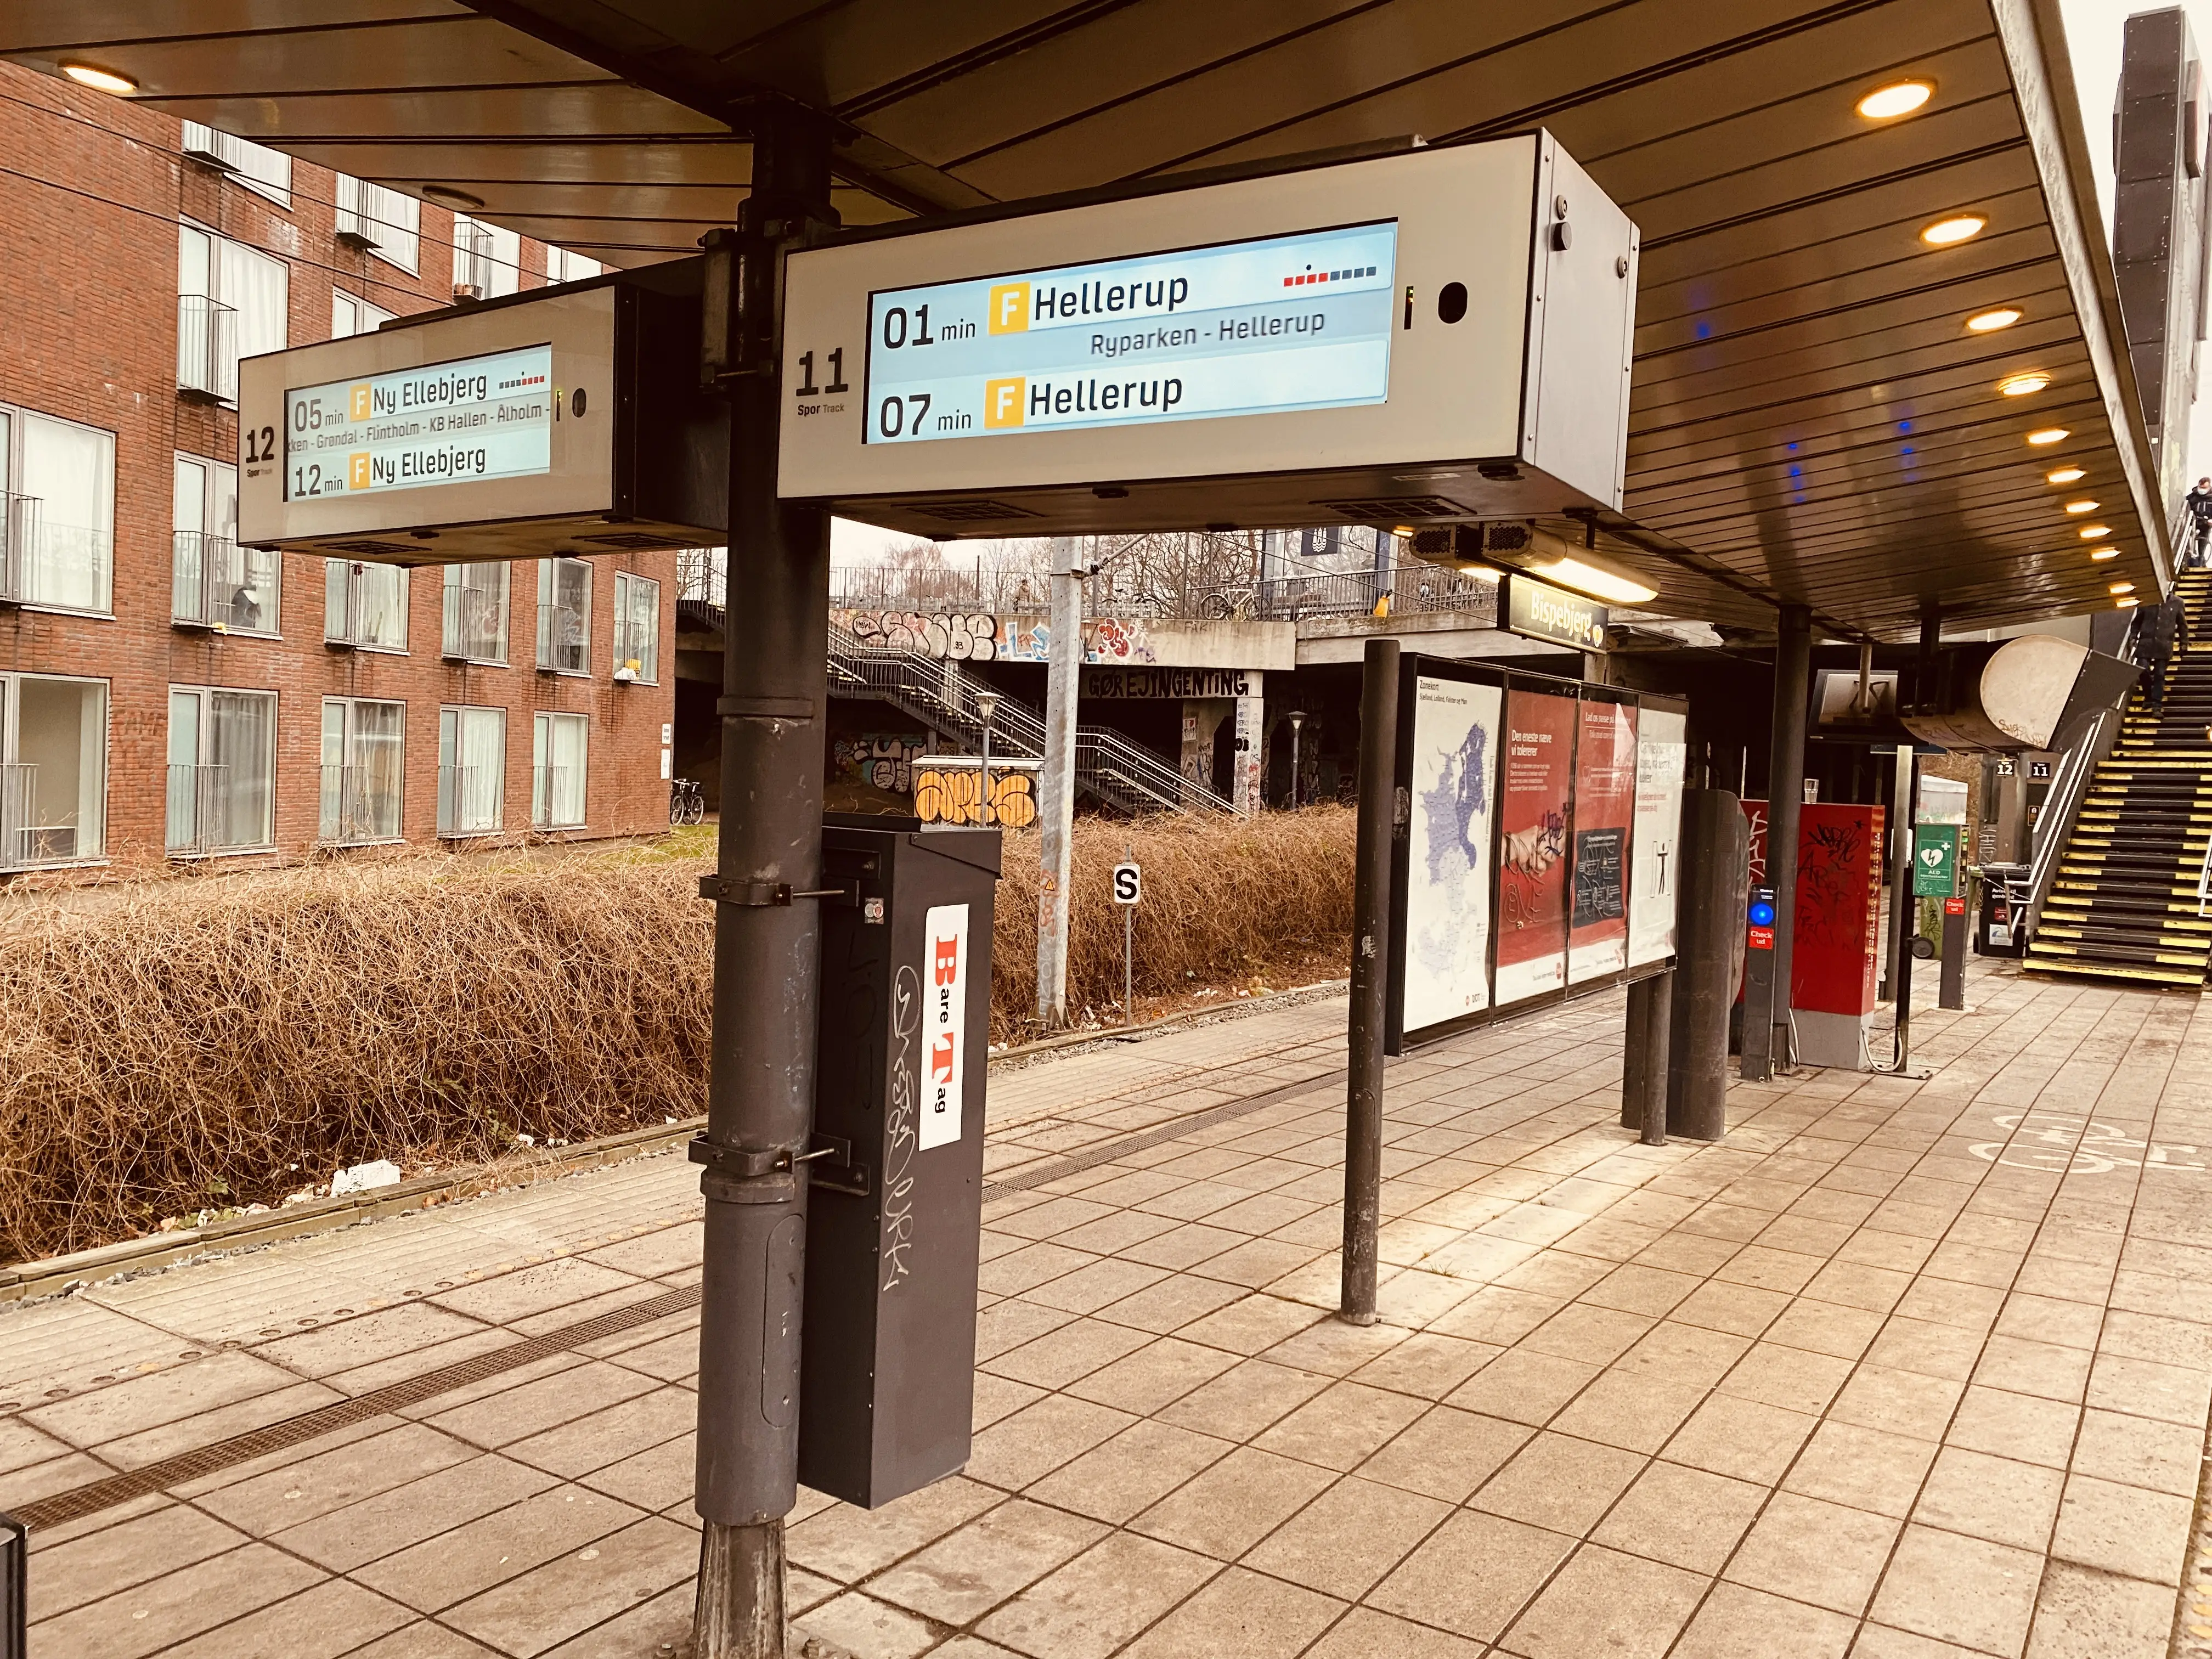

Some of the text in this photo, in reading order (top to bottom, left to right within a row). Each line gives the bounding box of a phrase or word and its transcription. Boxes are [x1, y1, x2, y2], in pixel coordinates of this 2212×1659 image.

[884, 277, 1188, 349] 01 min F Hellerup
[1091, 327, 1197, 358] Ryparken
[1219, 313, 1325, 341] Hellerup
[796, 347, 848, 397] 11
[295, 373, 487, 432] 05 min F Ny Ellebjerg
[430, 416, 444, 433] KB
[448, 412, 487, 430] Hallen
[497, 403, 542, 423] Ålholm
[798, 403, 845, 417] Spor Track
[881, 377, 1182, 437] 07 min F Hellerup
[246, 426, 274, 463] 12
[295, 445, 486, 497] 12 min F Ny Ellebjerg
[1531, 590, 1592, 641] Bispebjerg
[1512, 729, 1522, 742] Den
[1997, 764, 2013, 775] 12
[2033, 766, 2048, 776] 11
[1116, 868, 1138, 900] S
[1751, 930, 1773, 939] Check
[932, 934, 957, 1114] Bare Tag
